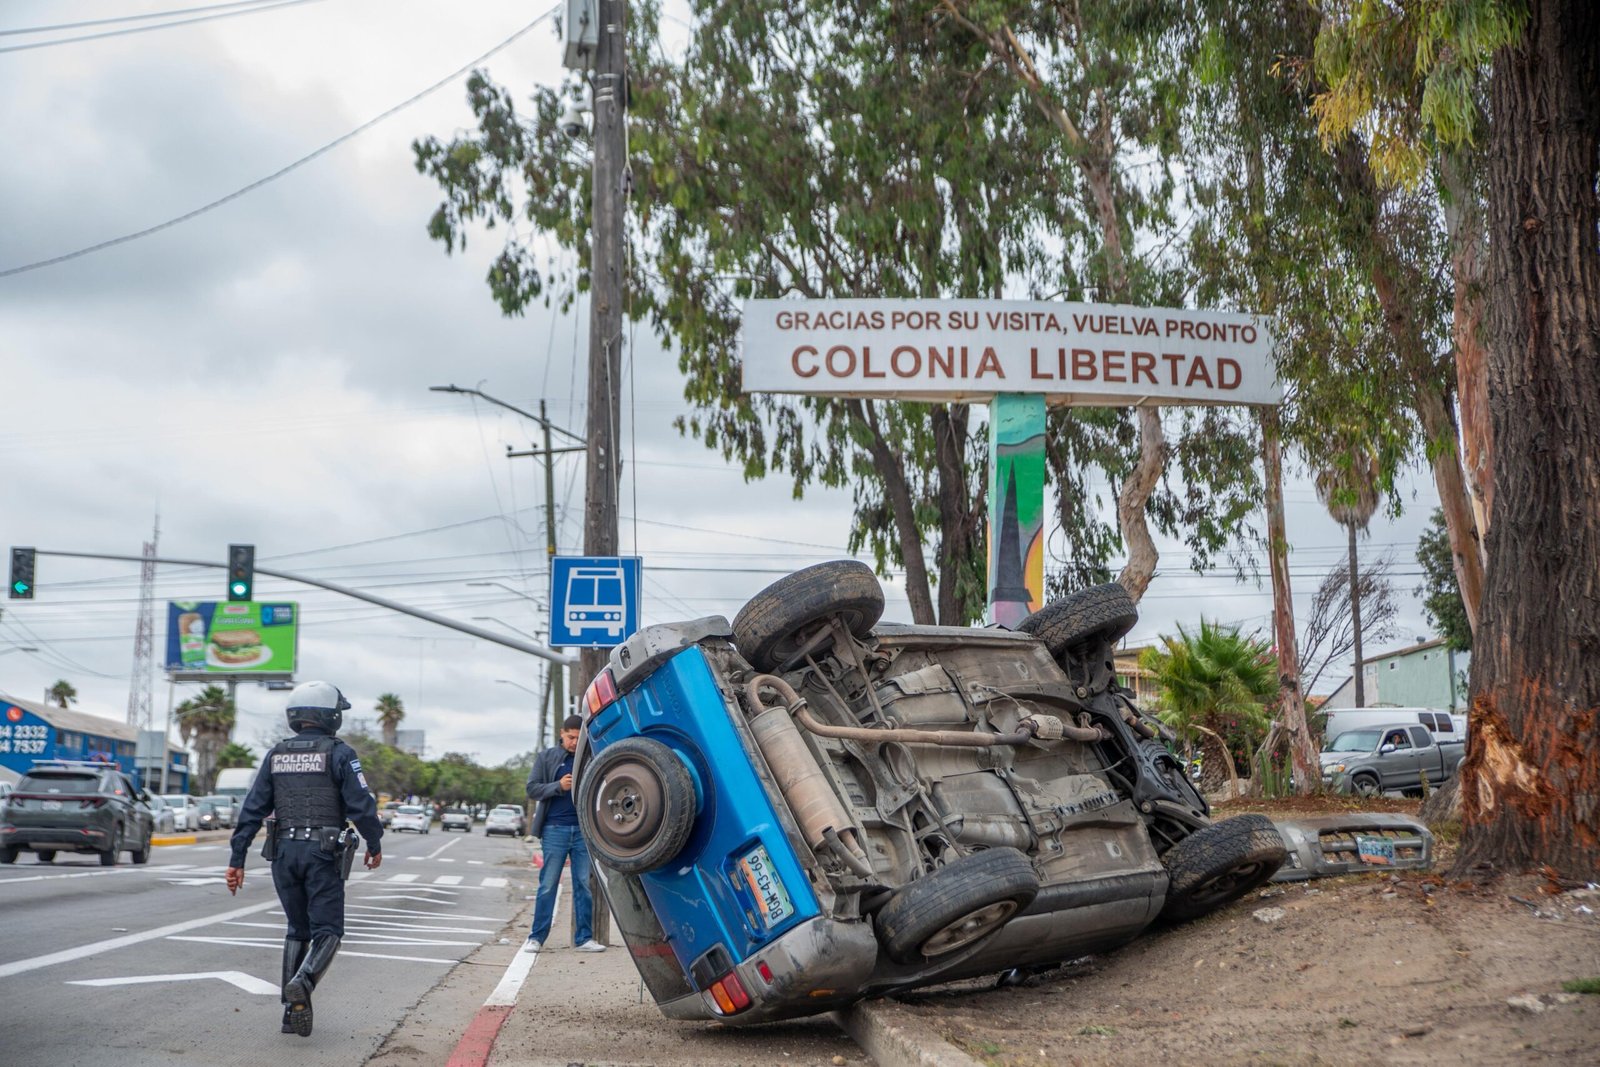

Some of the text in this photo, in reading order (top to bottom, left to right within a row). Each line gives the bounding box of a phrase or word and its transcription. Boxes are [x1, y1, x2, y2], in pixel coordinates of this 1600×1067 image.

[775, 311, 1258, 345] GRACIAS POR SU VISITA, VUELVA PRONTO
[791, 344, 1243, 390] COLONIA LIBERTAD
[14, 725, 48, 739] 2332
[13, 740, 48, 754] 7537
[273, 753, 322, 763] POLICIA
[273, 763, 322, 772] MUNICIPAL
